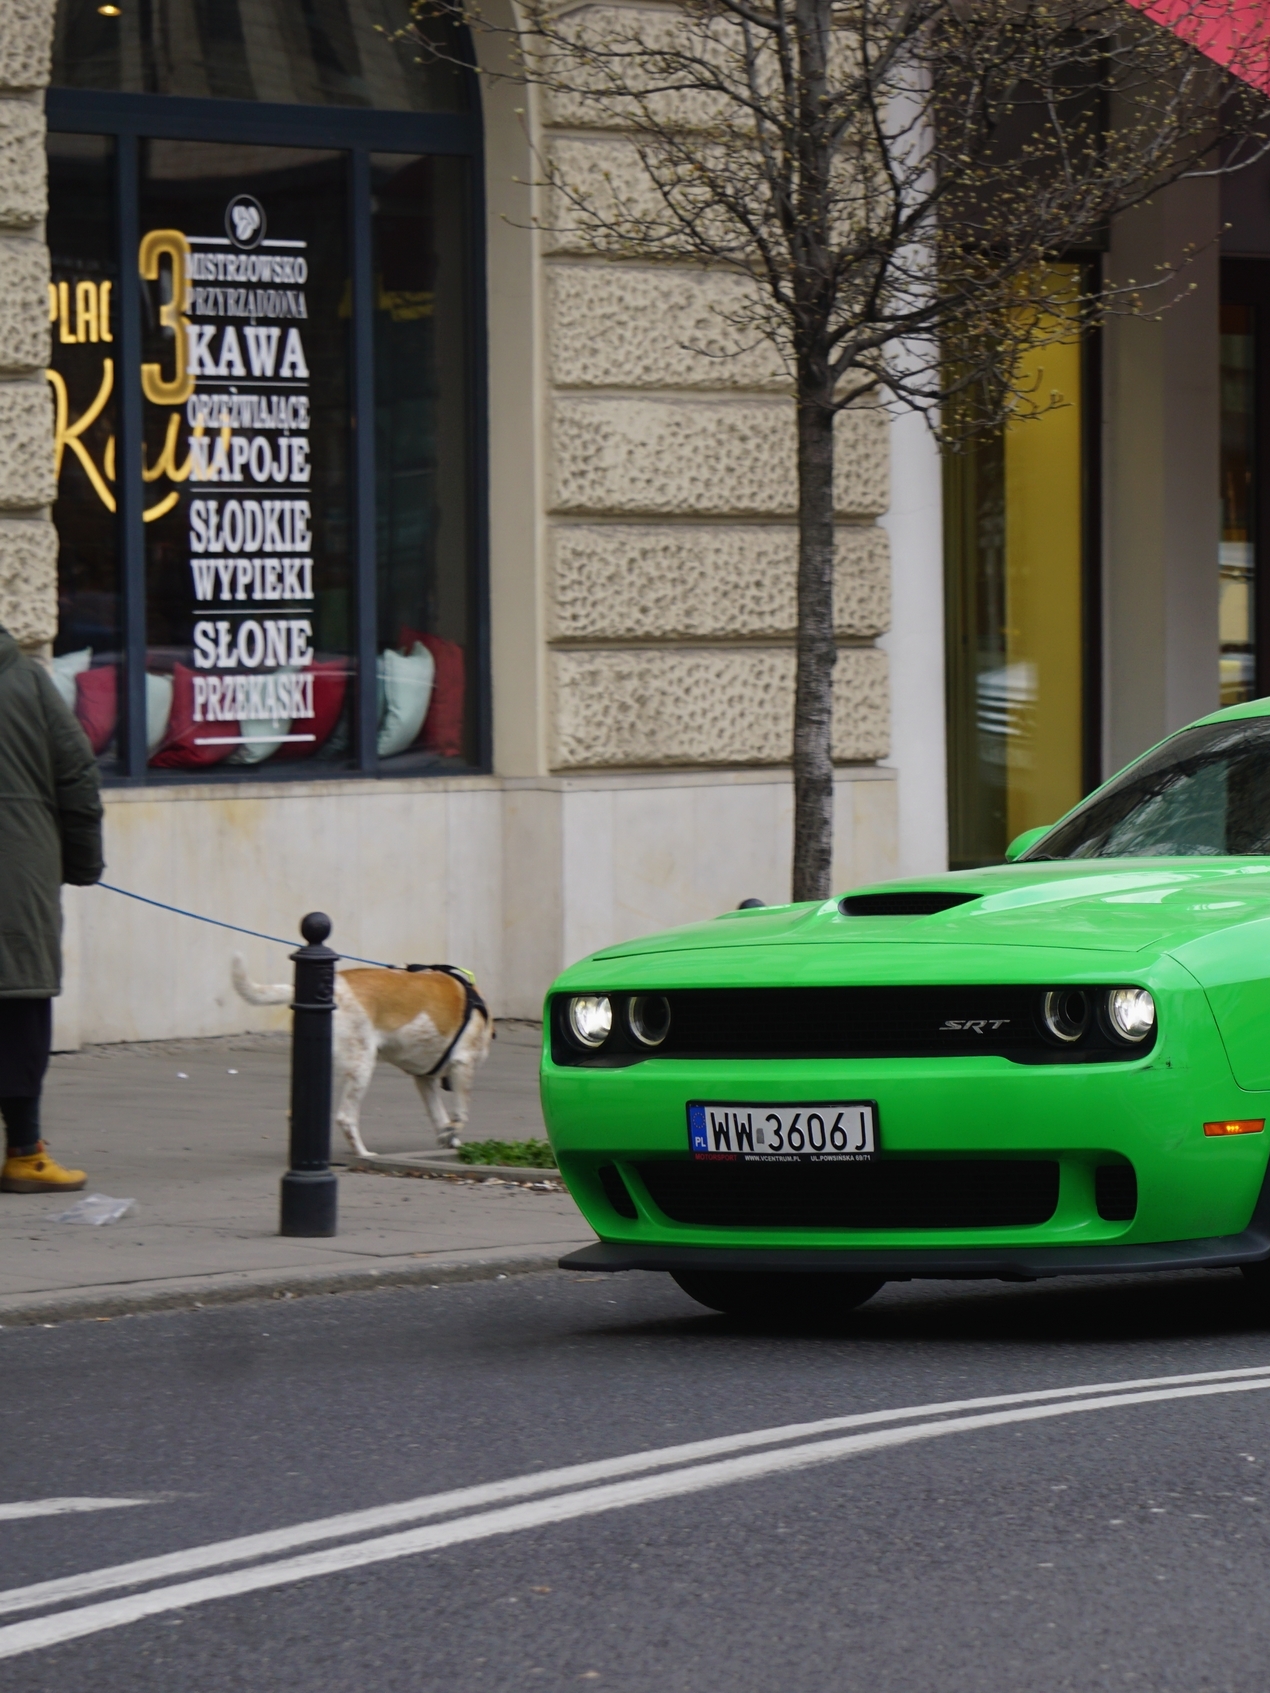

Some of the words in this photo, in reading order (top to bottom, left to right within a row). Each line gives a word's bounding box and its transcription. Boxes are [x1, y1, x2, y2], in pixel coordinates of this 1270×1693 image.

[185, 253, 308, 284] MISTRZOWSKO
[138, 229, 195, 405] 3
[185, 325, 309, 378] KAWA
[188, 436, 311, 482] NAPOJE
[189, 499, 313, 554] SŁODKIE
[190, 557, 315, 601] WYPIEKI
[193, 619, 315, 669] SŁONE
[193, 674, 316, 729] PRZEKĄSKI
[938, 1019, 1011, 1034] SRT
[694, 1136, 707, 1148] PL
[710, 1112, 755, 1152] WW
[765, 1111, 867, 1152] 3606J
[694, 1153, 738, 1161] MOTORSPORT
